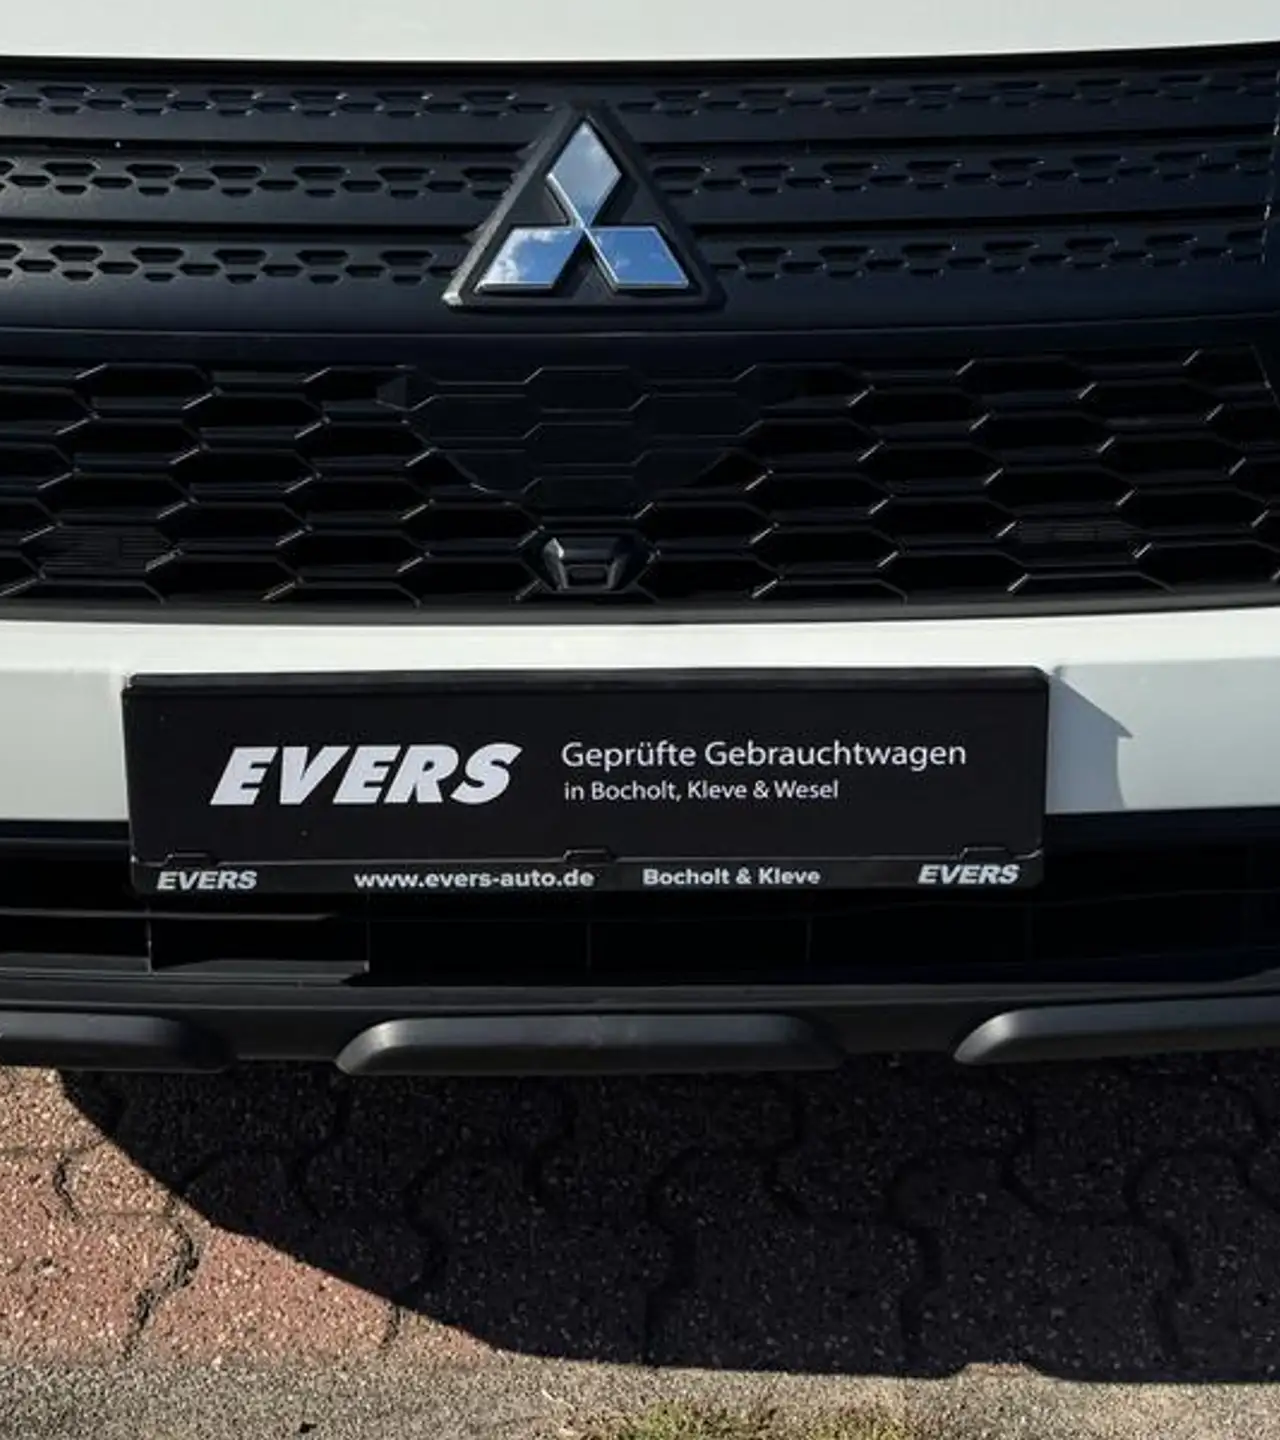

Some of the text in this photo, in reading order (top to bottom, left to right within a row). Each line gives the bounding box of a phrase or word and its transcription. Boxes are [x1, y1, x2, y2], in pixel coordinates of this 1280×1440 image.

[209, 738, 967, 806] EVERS Geprüfte Gebrauchtwagen
[564, 778, 840, 803] in Bocholt, Kleve & Wesel
[156, 863, 1020, 891] EVERS www.evers-auto.de Bocholt & Kleve EVERS
